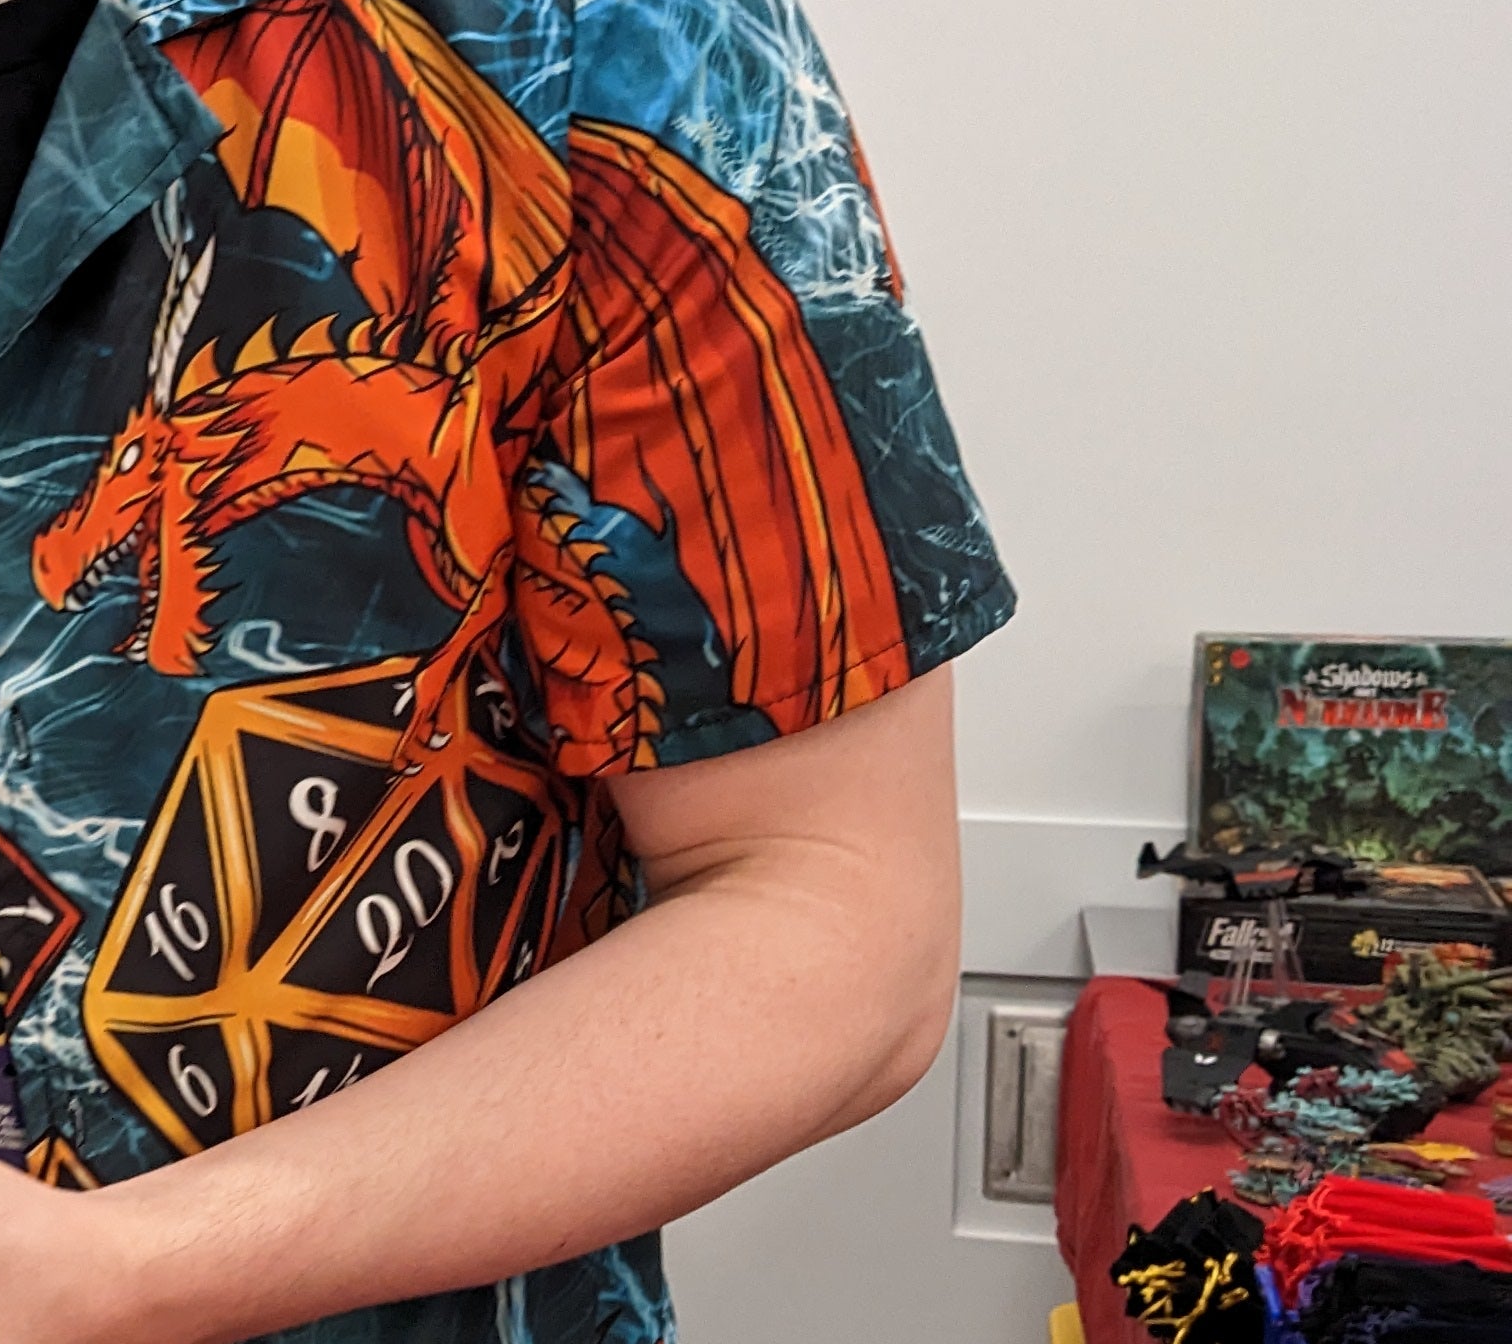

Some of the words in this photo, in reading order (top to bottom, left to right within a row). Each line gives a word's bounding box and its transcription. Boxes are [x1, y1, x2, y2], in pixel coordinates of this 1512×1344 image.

[288, 775, 348, 873] 8
[144, 882, 210, 982] 16
[355, 839, 454, 995] 20
[167, 1043, 219, 1117] 6
